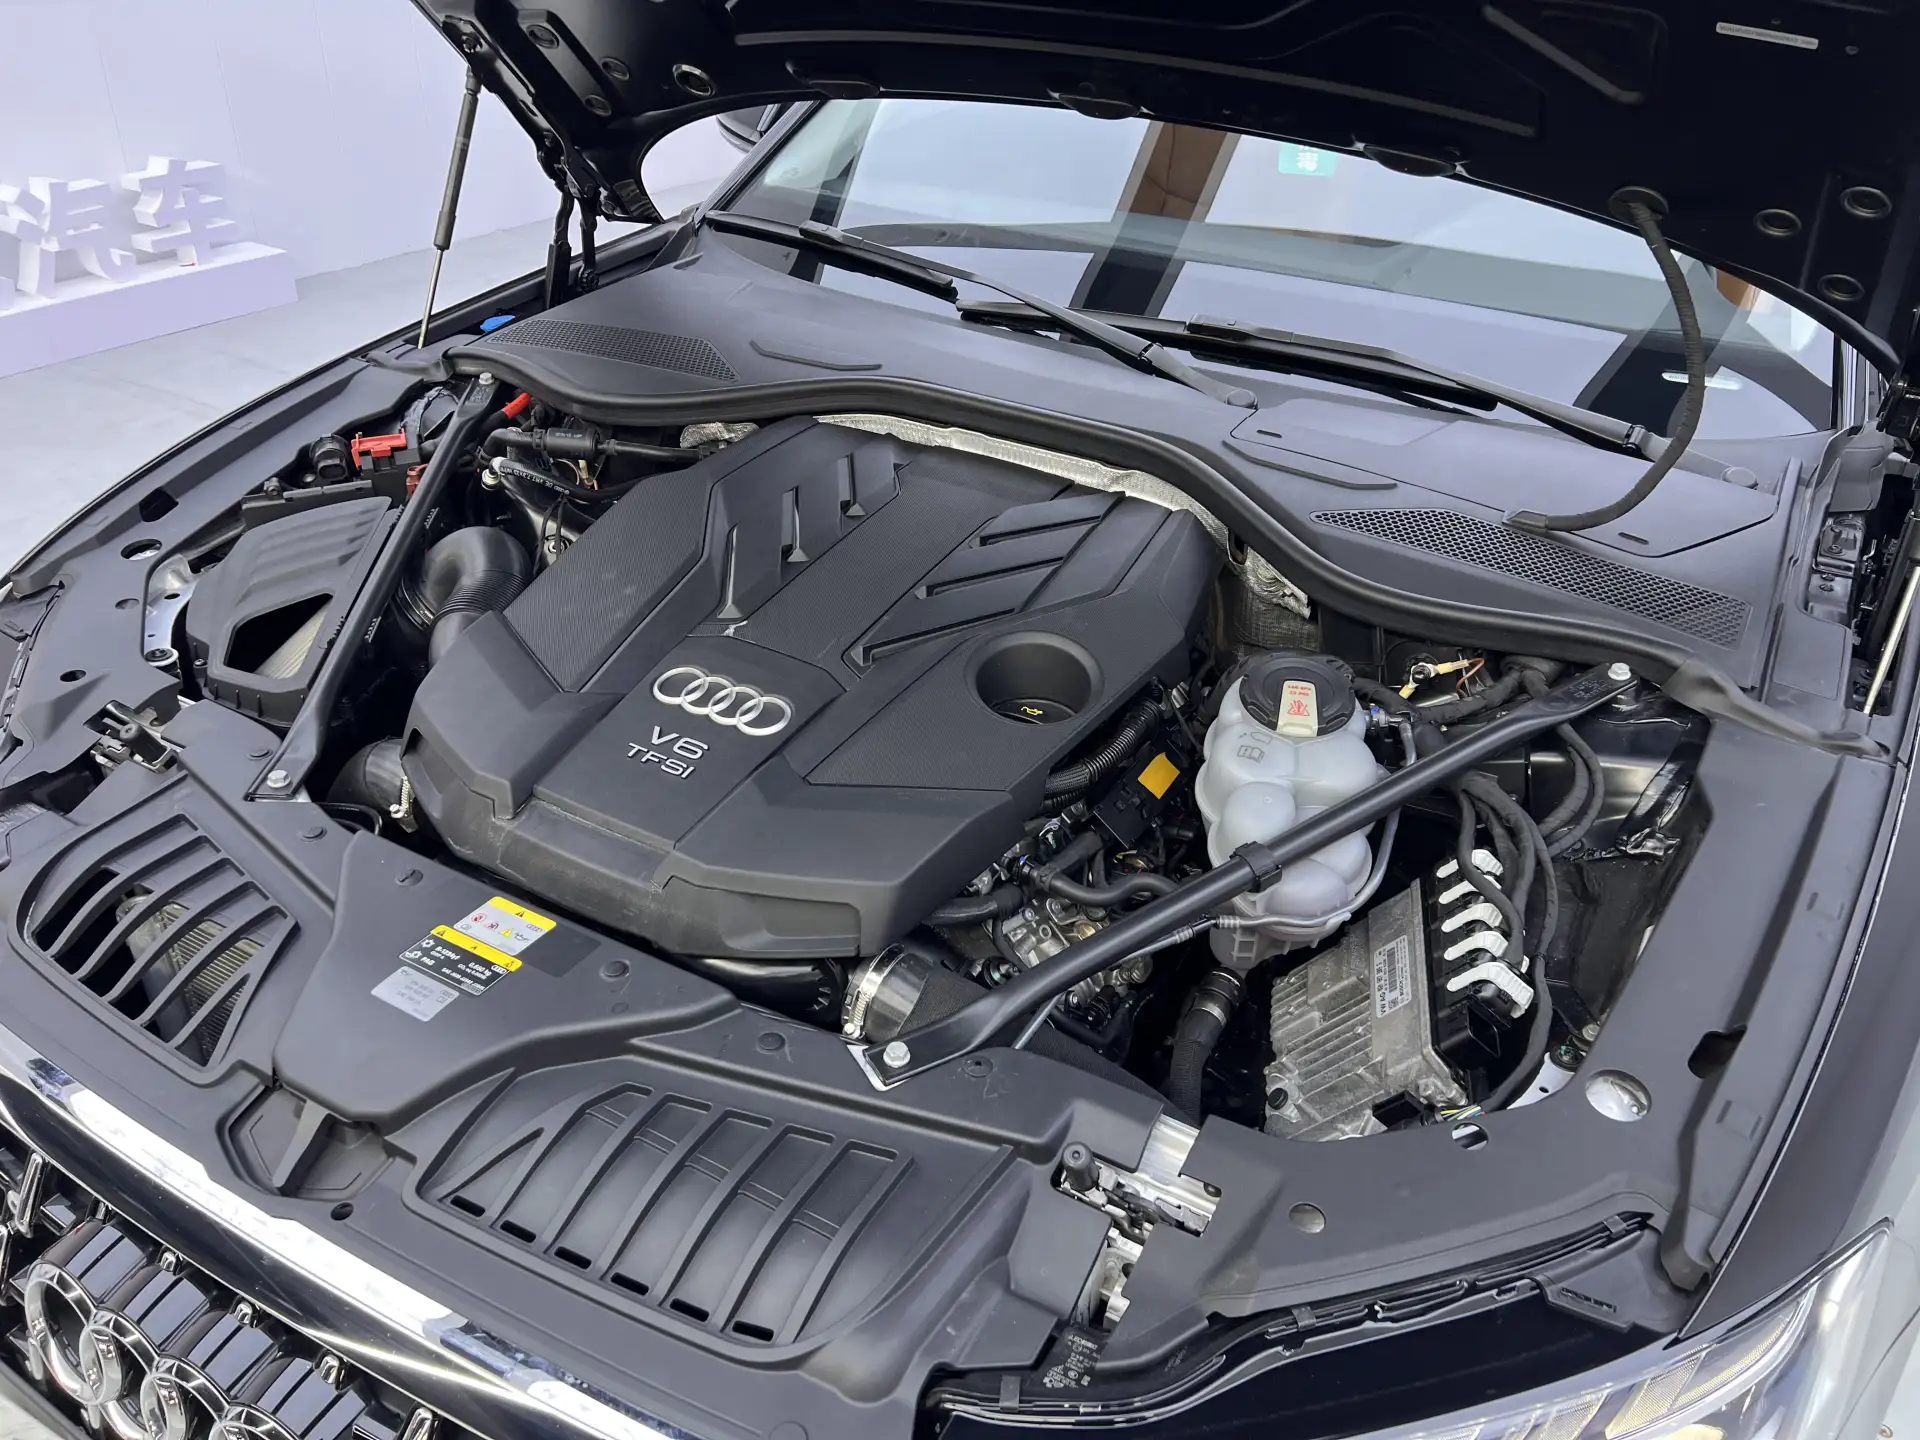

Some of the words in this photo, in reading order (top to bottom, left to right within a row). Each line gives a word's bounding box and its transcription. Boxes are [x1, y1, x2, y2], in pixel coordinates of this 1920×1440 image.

[0, 155, 240, 310] 汽车
[627, 742, 695, 779] TFSI
[651, 725, 709, 760] V6
